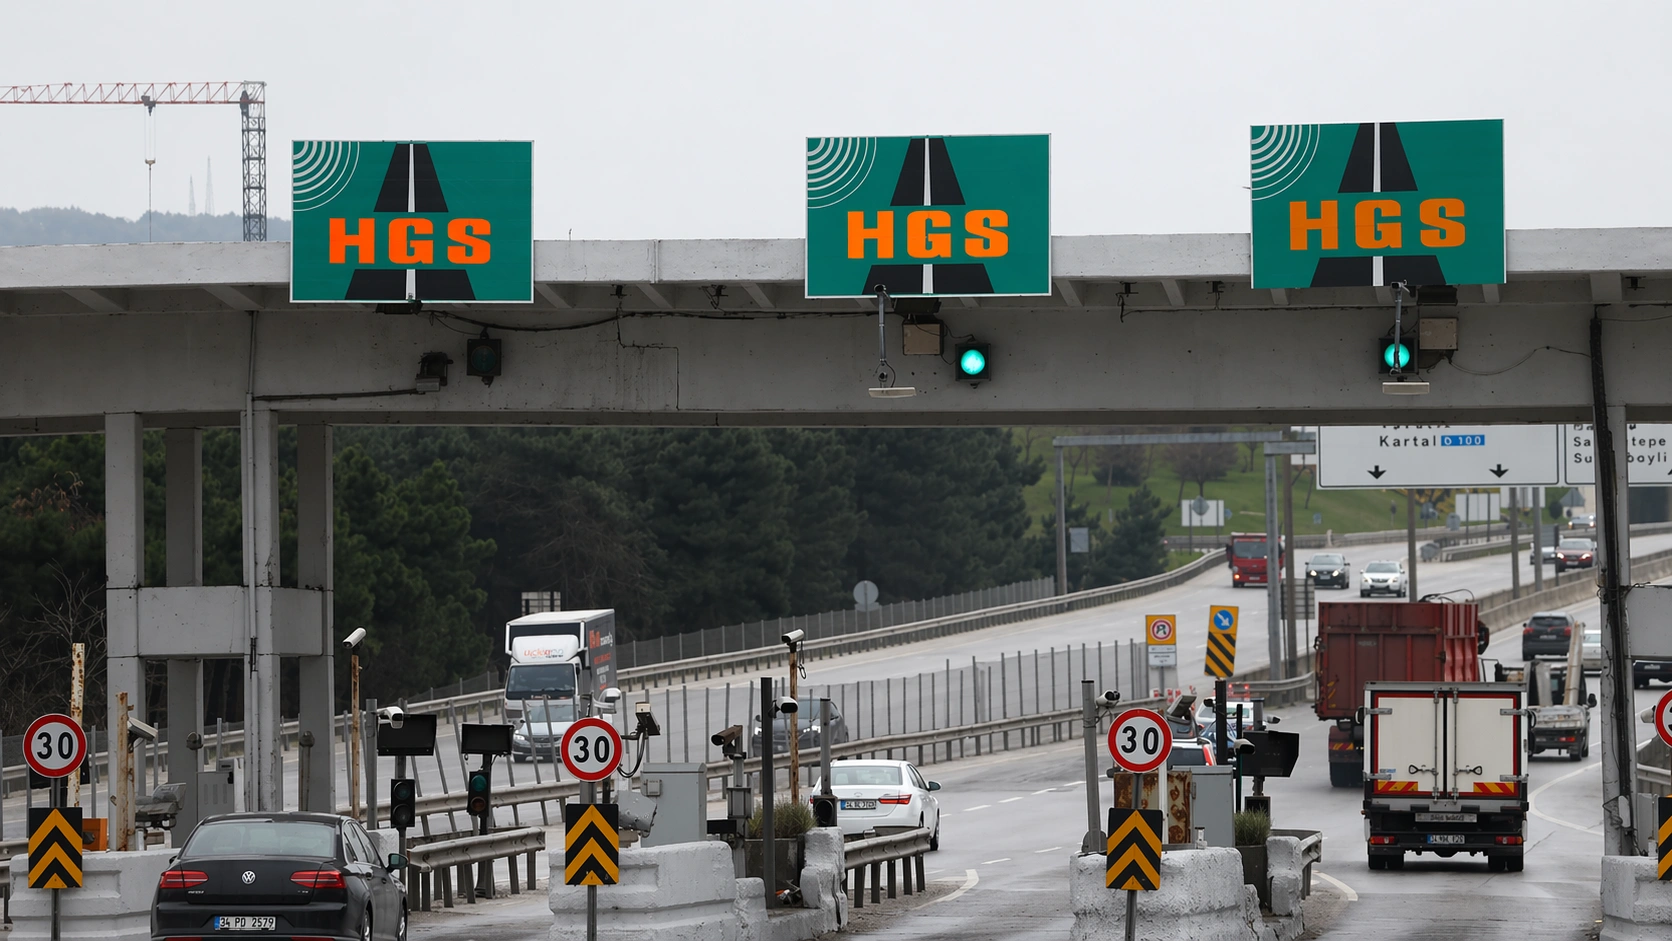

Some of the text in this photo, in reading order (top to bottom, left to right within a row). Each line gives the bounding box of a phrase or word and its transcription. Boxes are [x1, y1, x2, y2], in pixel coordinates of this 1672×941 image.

[847, 209, 1009, 259] HGS
[1290, 198, 1465, 250] HGS
[329, 217, 491, 265] HGS
[1379, 435, 1436, 447] Kartal
[1458, 436, 1482, 445] 100
[36, 731, 74, 760] 30
[573, 735, 610, 763] 30
[1121, 725, 1159, 755] 30
[220, 917, 230, 928] 34
[251, 917, 274, 928] 2579
